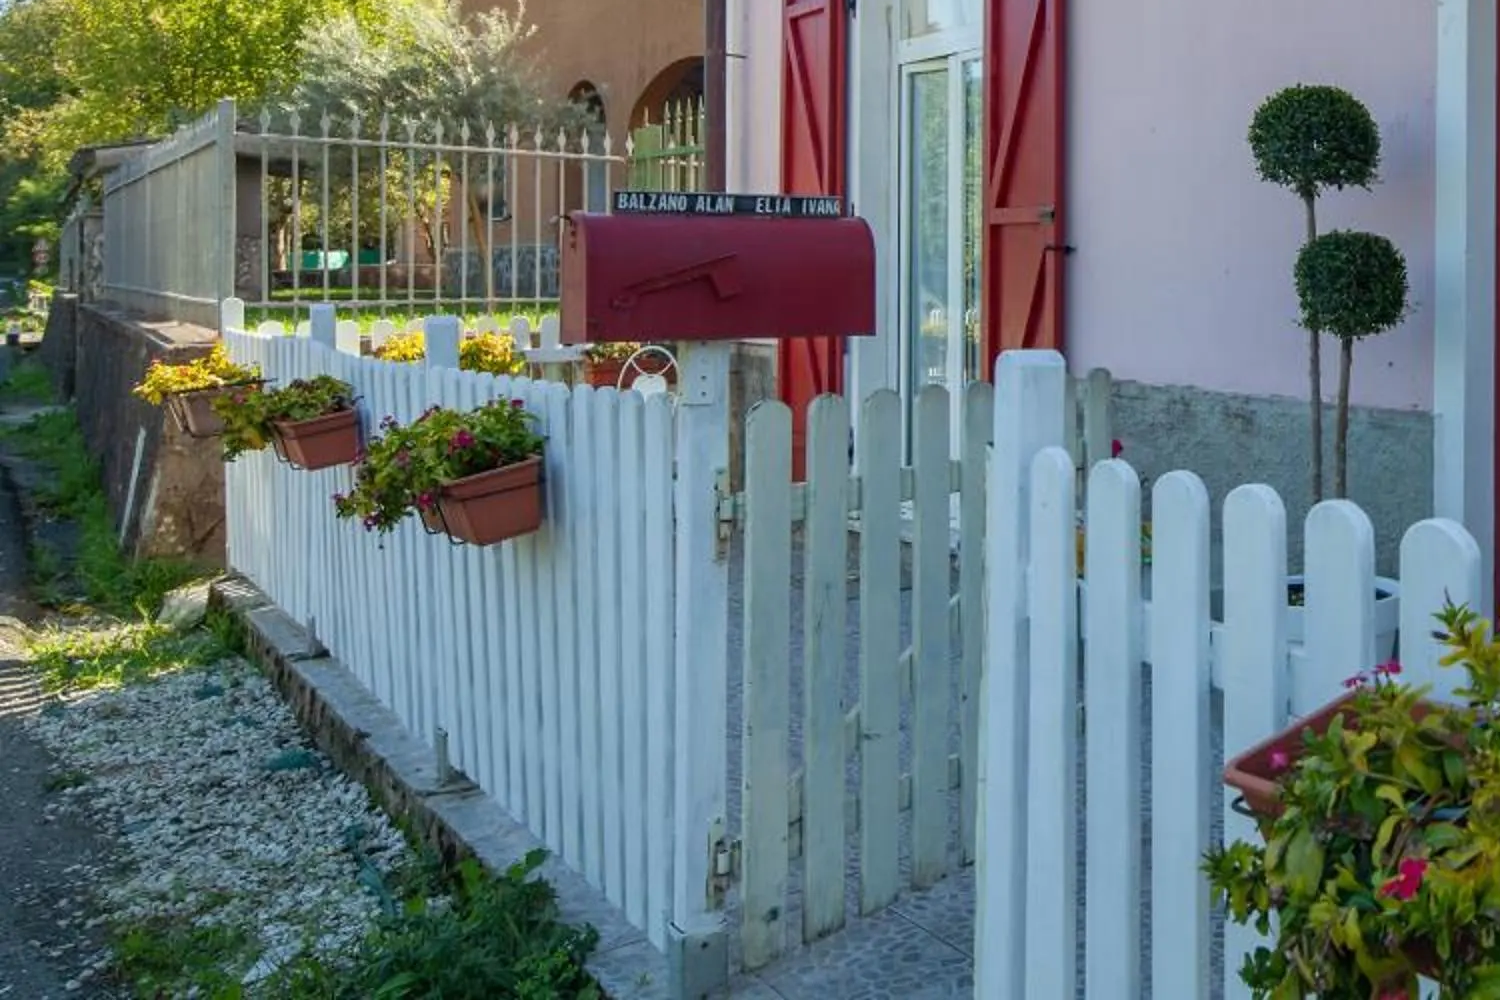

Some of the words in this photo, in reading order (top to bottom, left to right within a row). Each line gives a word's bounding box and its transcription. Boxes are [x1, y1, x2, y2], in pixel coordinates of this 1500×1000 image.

[617, 193, 687, 213] BALZANO
[695, 195, 735, 214] ALAN
[755, 197, 792, 214] ELIA
[801, 198, 841, 216] IVANA
